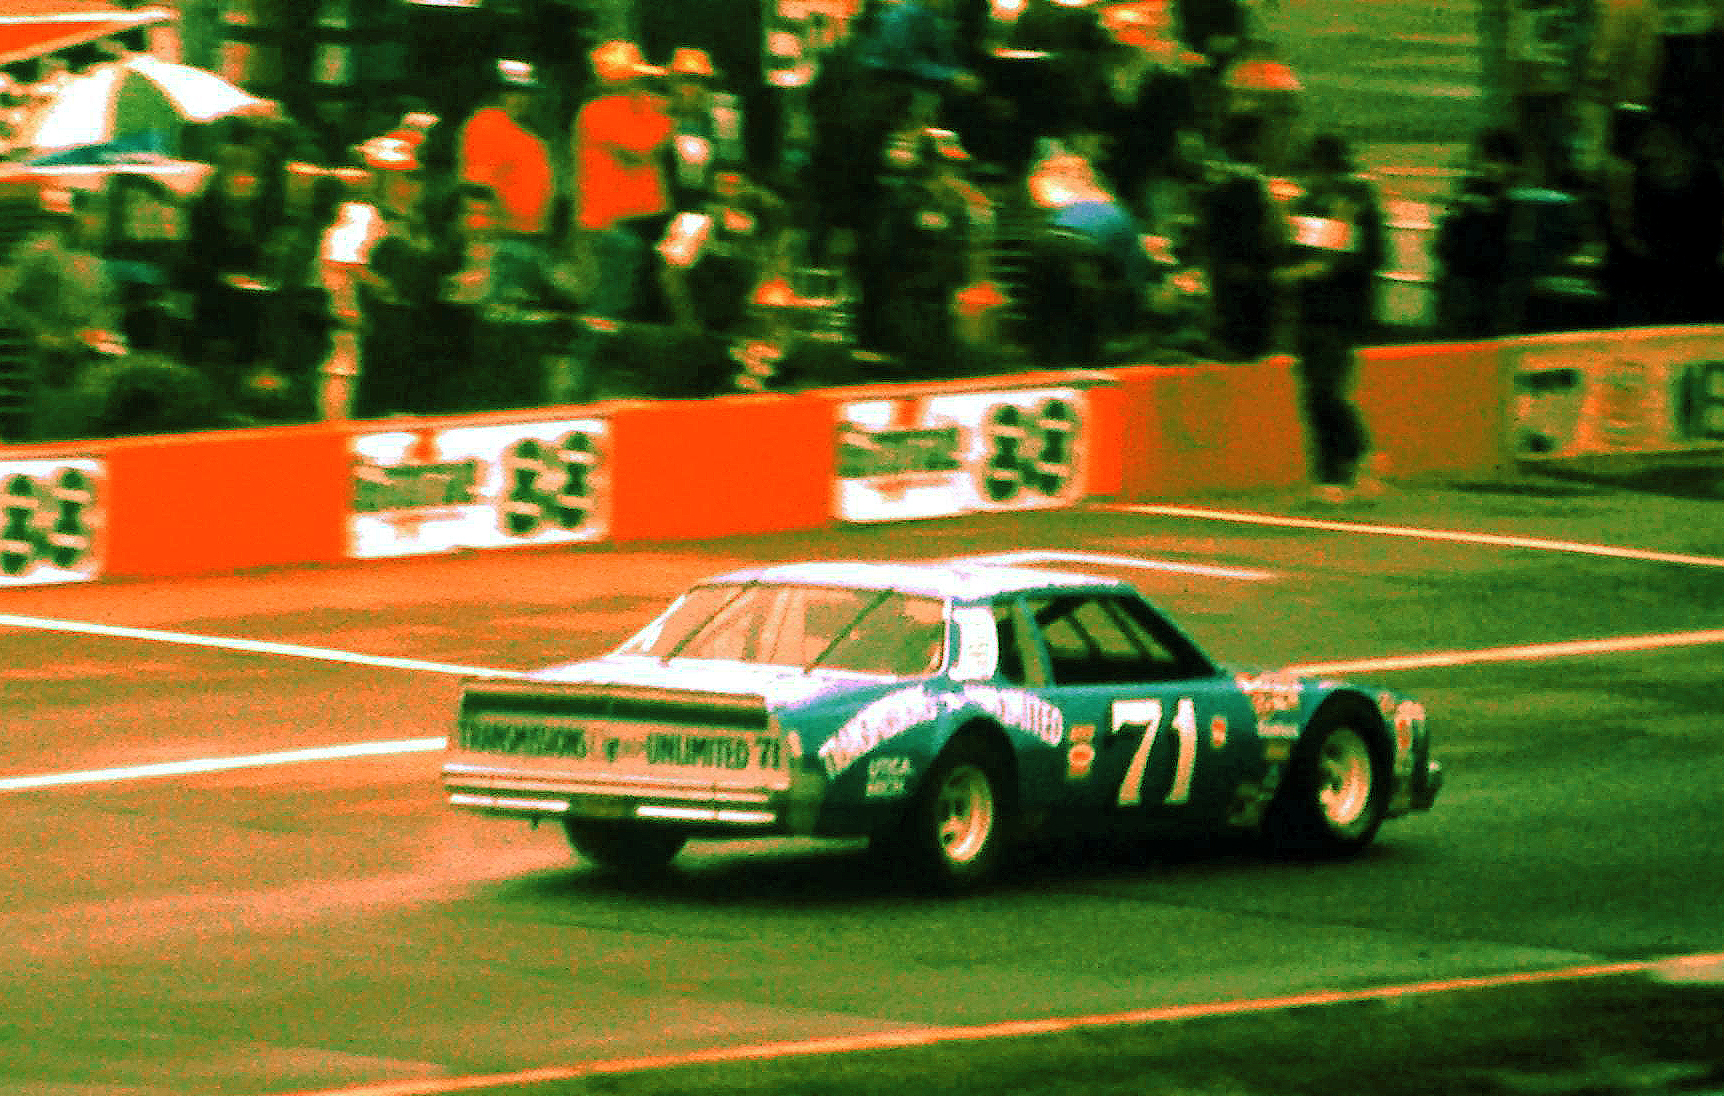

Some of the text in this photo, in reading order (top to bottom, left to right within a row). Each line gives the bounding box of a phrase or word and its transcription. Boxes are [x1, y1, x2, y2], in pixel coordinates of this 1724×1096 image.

[646, 733, 749, 769] UNLIMITED
[755, 736, 780, 769] 71
[1112, 698, 1198, 806] 71
